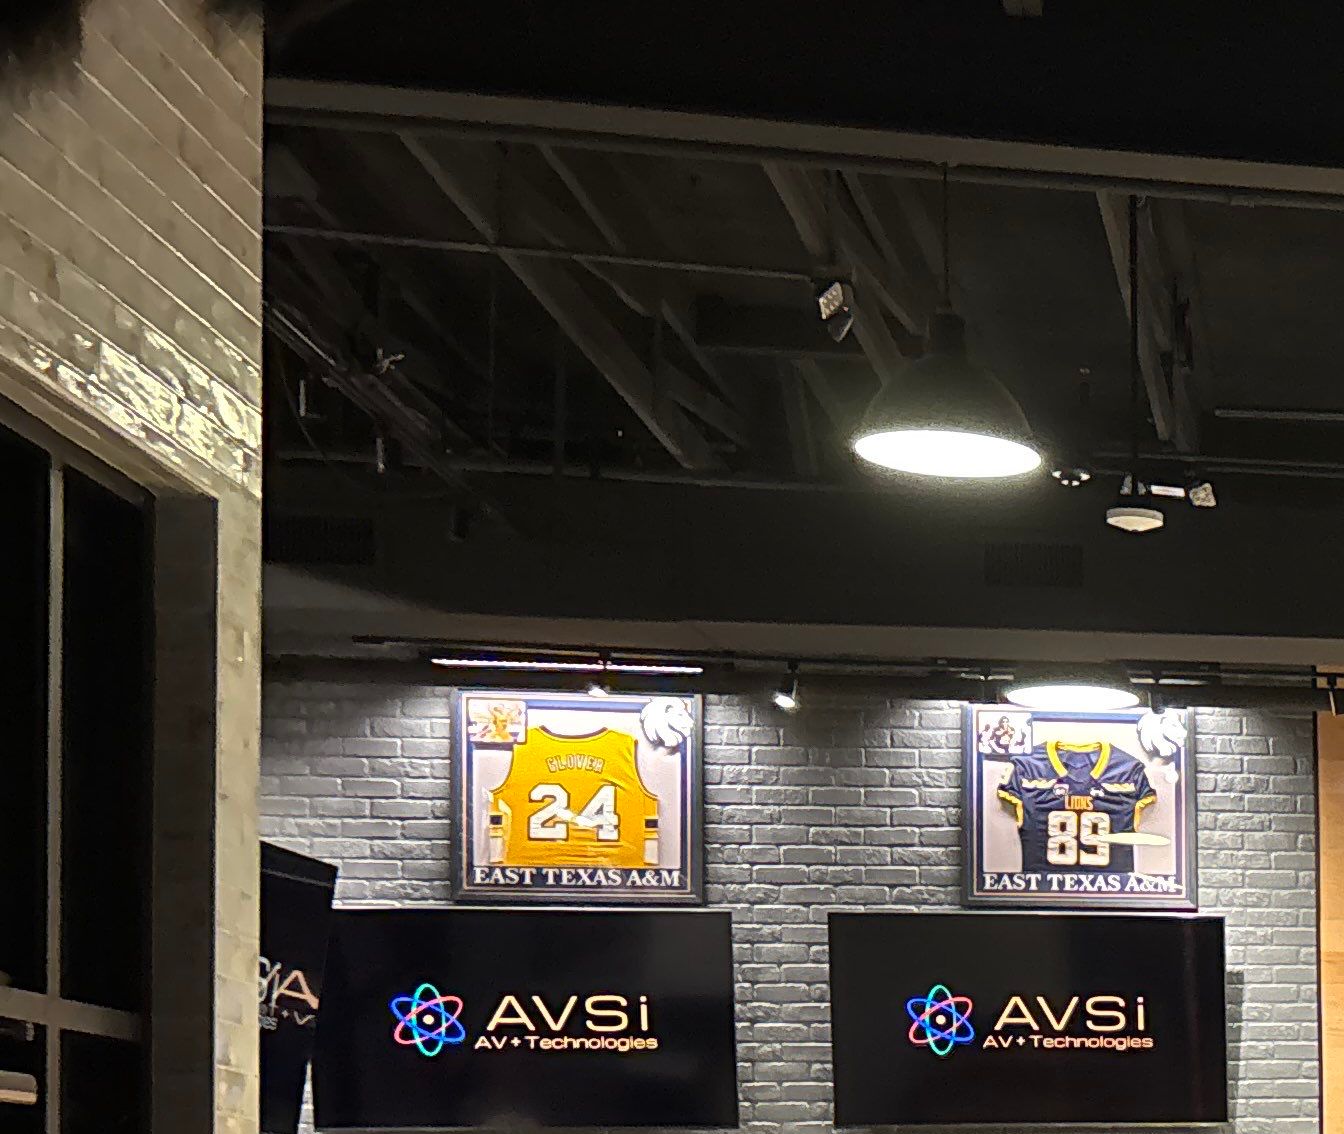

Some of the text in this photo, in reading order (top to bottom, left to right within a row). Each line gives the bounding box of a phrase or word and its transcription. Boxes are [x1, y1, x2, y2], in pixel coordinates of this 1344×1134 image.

[546, 753, 606, 774] GLOVER
[527, 783, 621, 842] 24
[1046, 810, 1111, 867] 89
[474, 867, 681, 887] EAST TEXAS A&M
[983, 872, 1177, 893] EAST TEXAS A&M
[486, 994, 649, 1032] AVSi
[993, 995, 1145, 1032] AVSi
